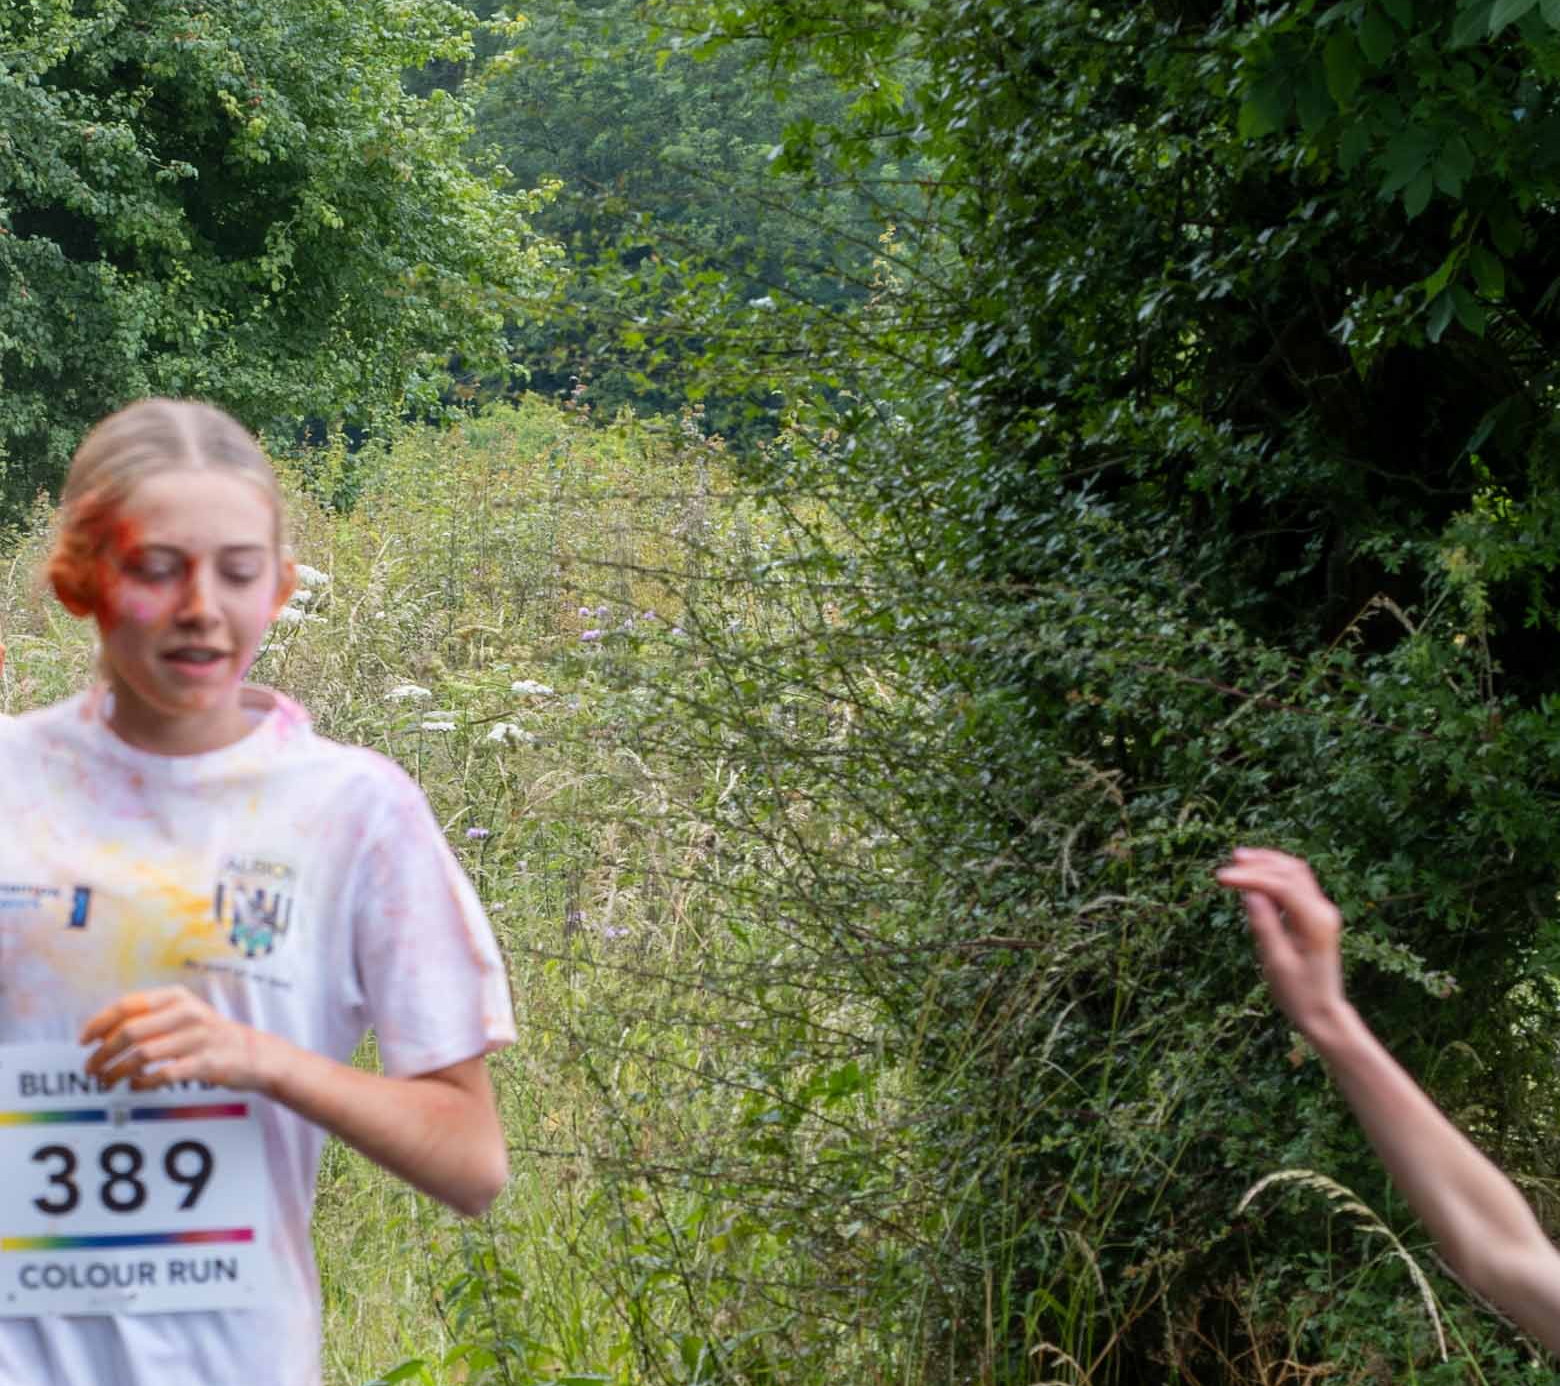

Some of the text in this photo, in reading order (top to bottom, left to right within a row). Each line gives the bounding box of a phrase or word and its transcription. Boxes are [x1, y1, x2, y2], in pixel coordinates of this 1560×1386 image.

[31, 1140, 214, 1216] 389
[17, 1257, 239, 1290] COLOUR RUN
